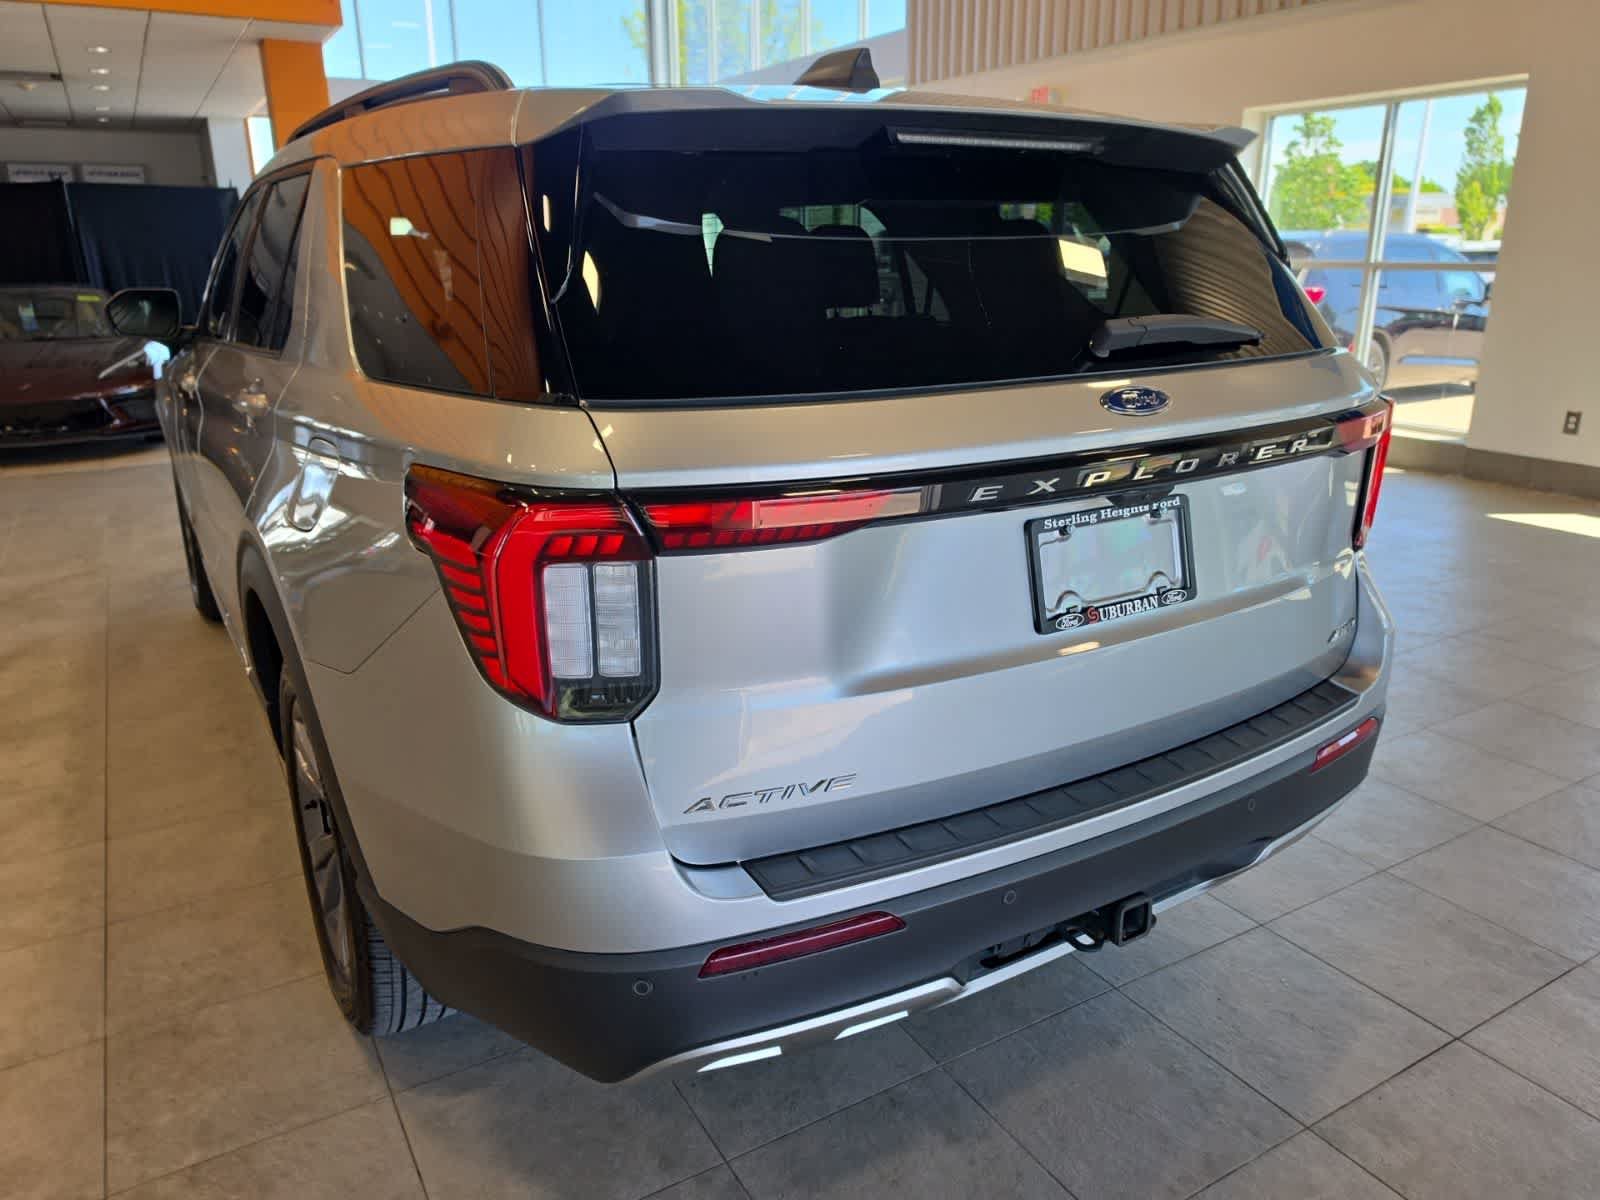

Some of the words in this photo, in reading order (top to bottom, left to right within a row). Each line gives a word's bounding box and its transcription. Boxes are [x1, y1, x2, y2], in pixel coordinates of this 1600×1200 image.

[969, 438, 1308, 502] EXPLORER
[1044, 511, 1097, 529] Sterling
[1100, 503, 1150, 519] Heights
[1060, 615, 1080, 628] Ford
[1088, 595, 1159, 624] SUBURBAN
[1165, 591, 1184, 603] Ford
[683, 773, 857, 814] ACTIVE
